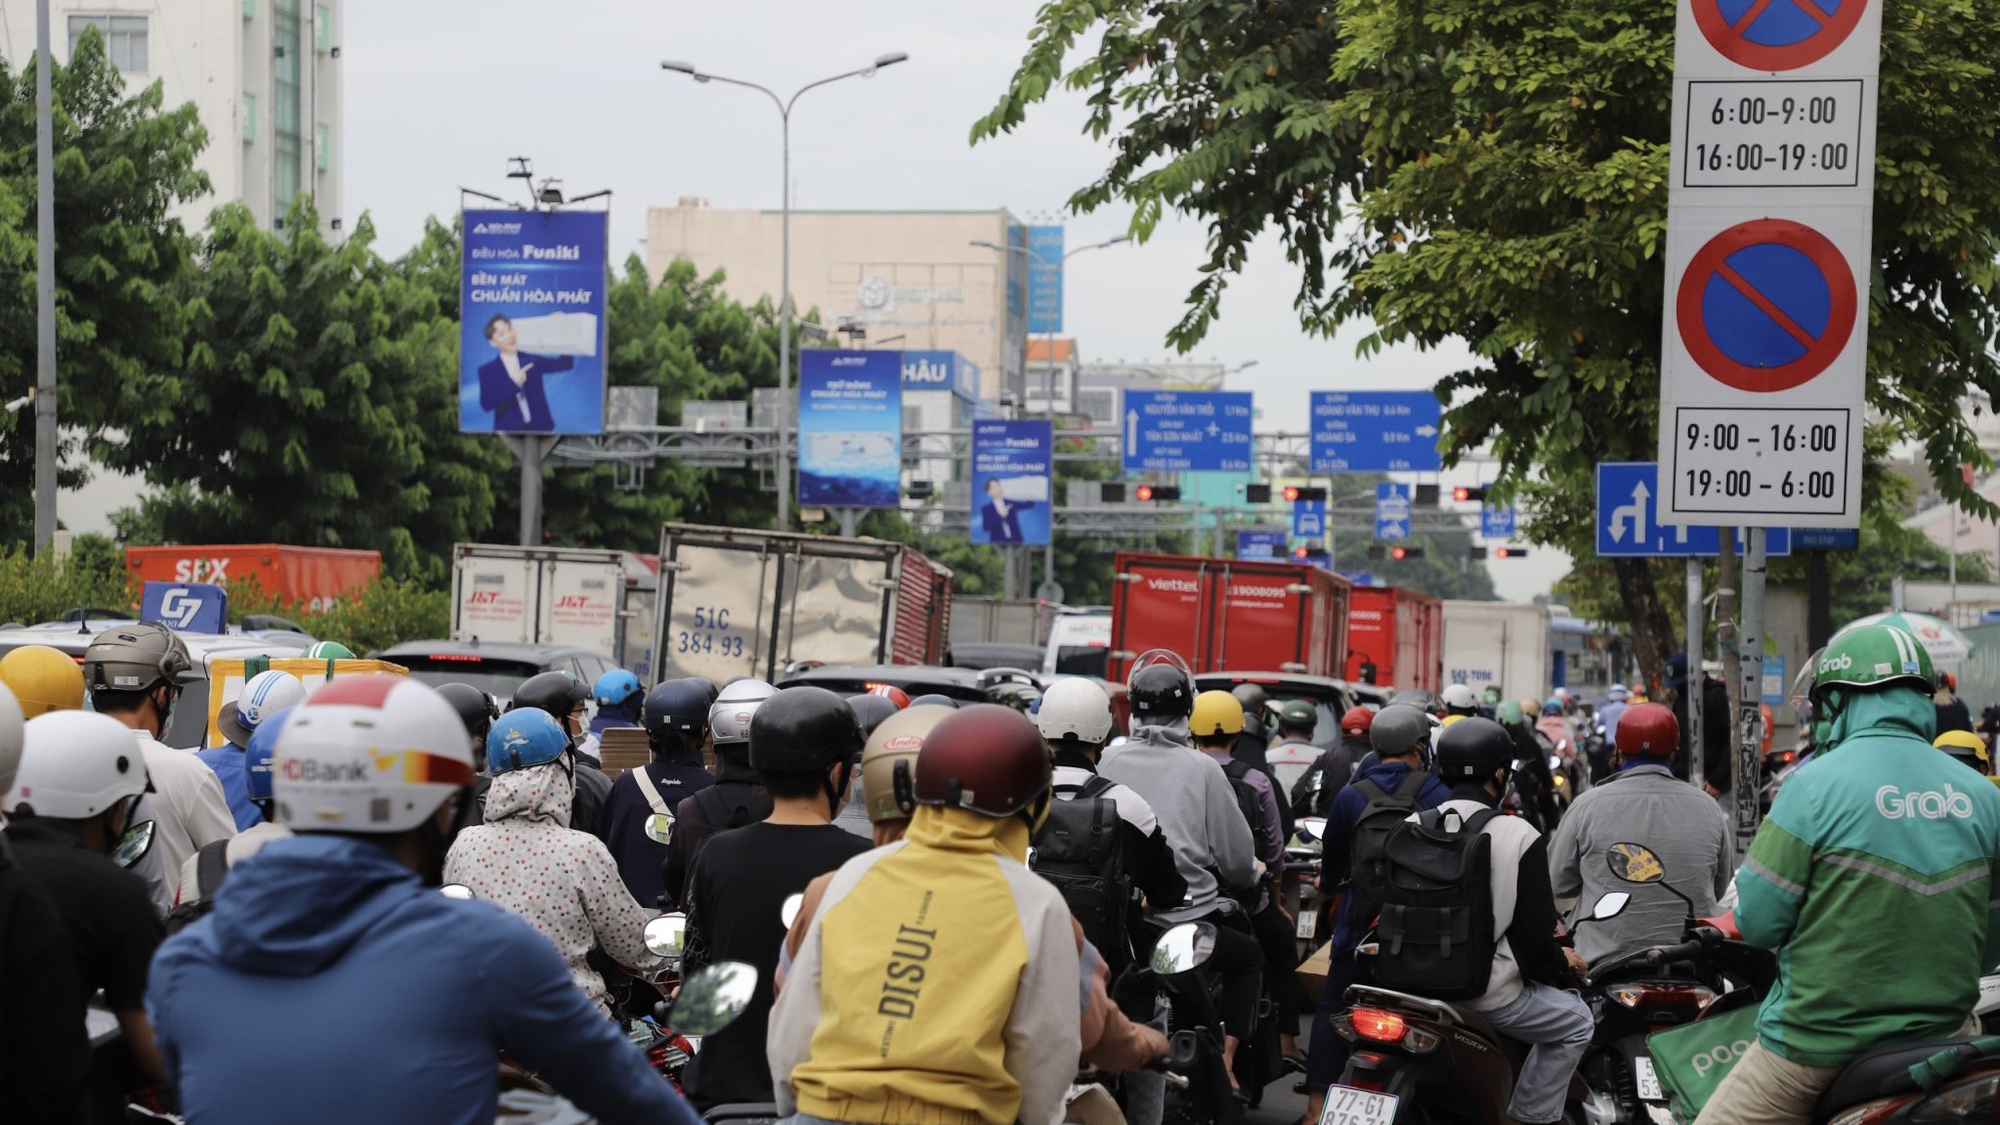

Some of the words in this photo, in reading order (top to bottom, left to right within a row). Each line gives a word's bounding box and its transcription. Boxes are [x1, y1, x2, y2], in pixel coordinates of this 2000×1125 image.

[1711, 96, 1836, 125] 6:00-9:00
[1696, 142, 1848, 171] 16:00-19:00
[522, 244, 579, 260] Funiki
[501, 272, 528, 285] MÁT
[557, 288, 593, 304] PHÁT
[1687, 423, 1739, 451] 9:00
[1770, 424, 1837, 452] 16:00
[1686, 469, 1751, 497] 19:00
[1781, 471, 1835, 499] 6:00
[175, 557, 230, 585] SPX
[160, 588, 203, 628] G7
[694, 606, 730, 631] 51C
[678, 632, 744, 657] 384.93
[1819, 652, 1852, 675] Grab
[1875, 783, 1973, 819] Grab
[877, 923, 937, 1020] DISUI
[1335, 1090, 1385, 1117] 77-G1
